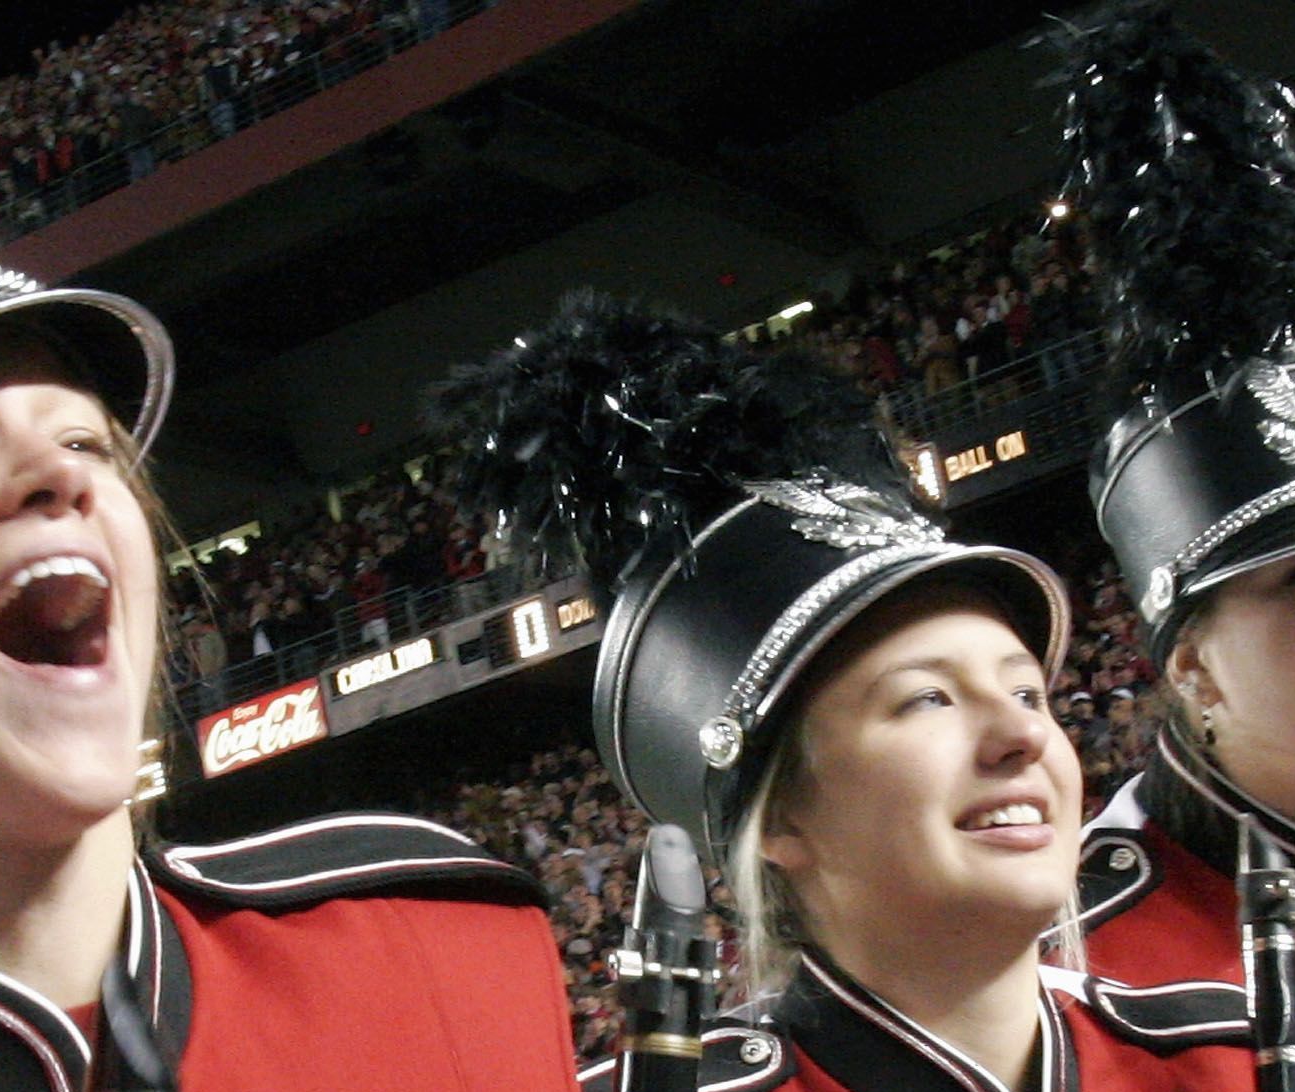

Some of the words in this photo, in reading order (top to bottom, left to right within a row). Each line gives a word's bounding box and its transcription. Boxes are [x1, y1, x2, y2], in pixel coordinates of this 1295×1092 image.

[945, 446, 994, 482] BALL
[996, 431, 1026, 462] ON
[512, 601, 551, 659] 0
[204, 685, 320, 773] Coca-Cola
